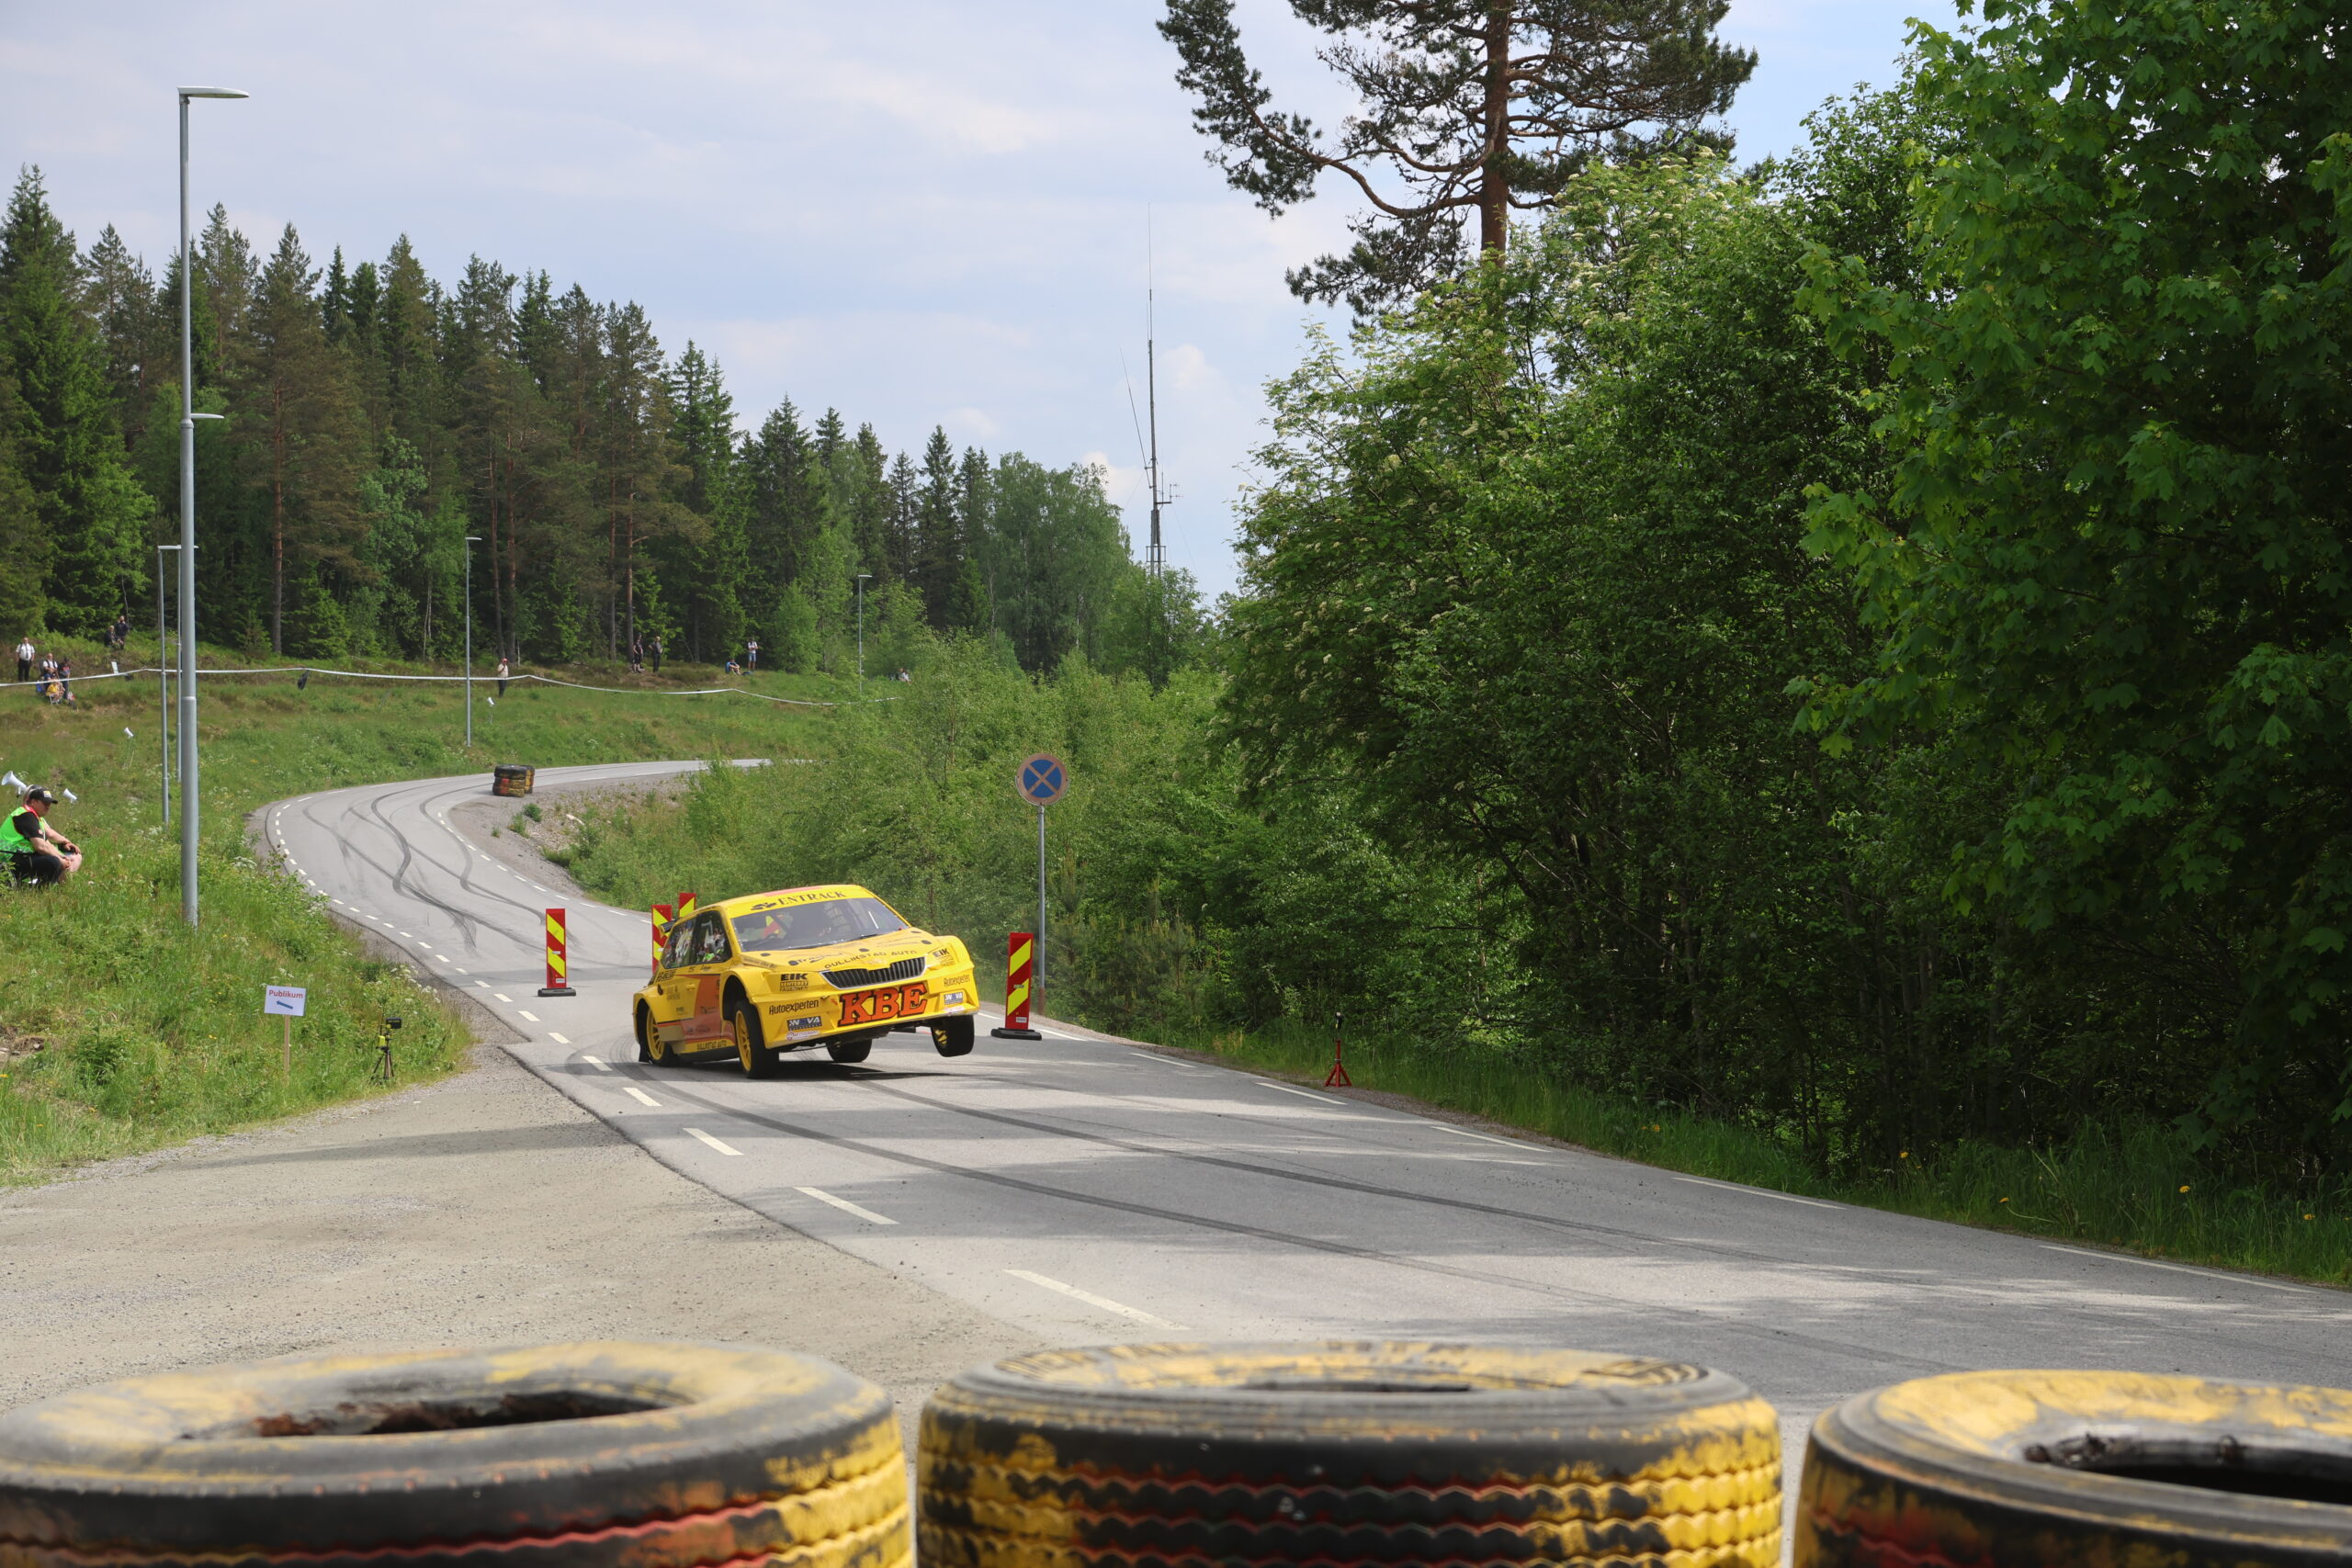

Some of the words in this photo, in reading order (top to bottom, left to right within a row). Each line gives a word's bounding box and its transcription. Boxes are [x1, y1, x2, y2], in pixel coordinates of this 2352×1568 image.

[777, 891, 846, 905] ENTRACK
[933, 948, 950, 958] EIK
[780, 973, 808, 981] EIK
[268, 989, 303, 999] Publikum
[769, 999, 820, 1015] Autoexperten
[838, 982, 928, 1027] KBE
